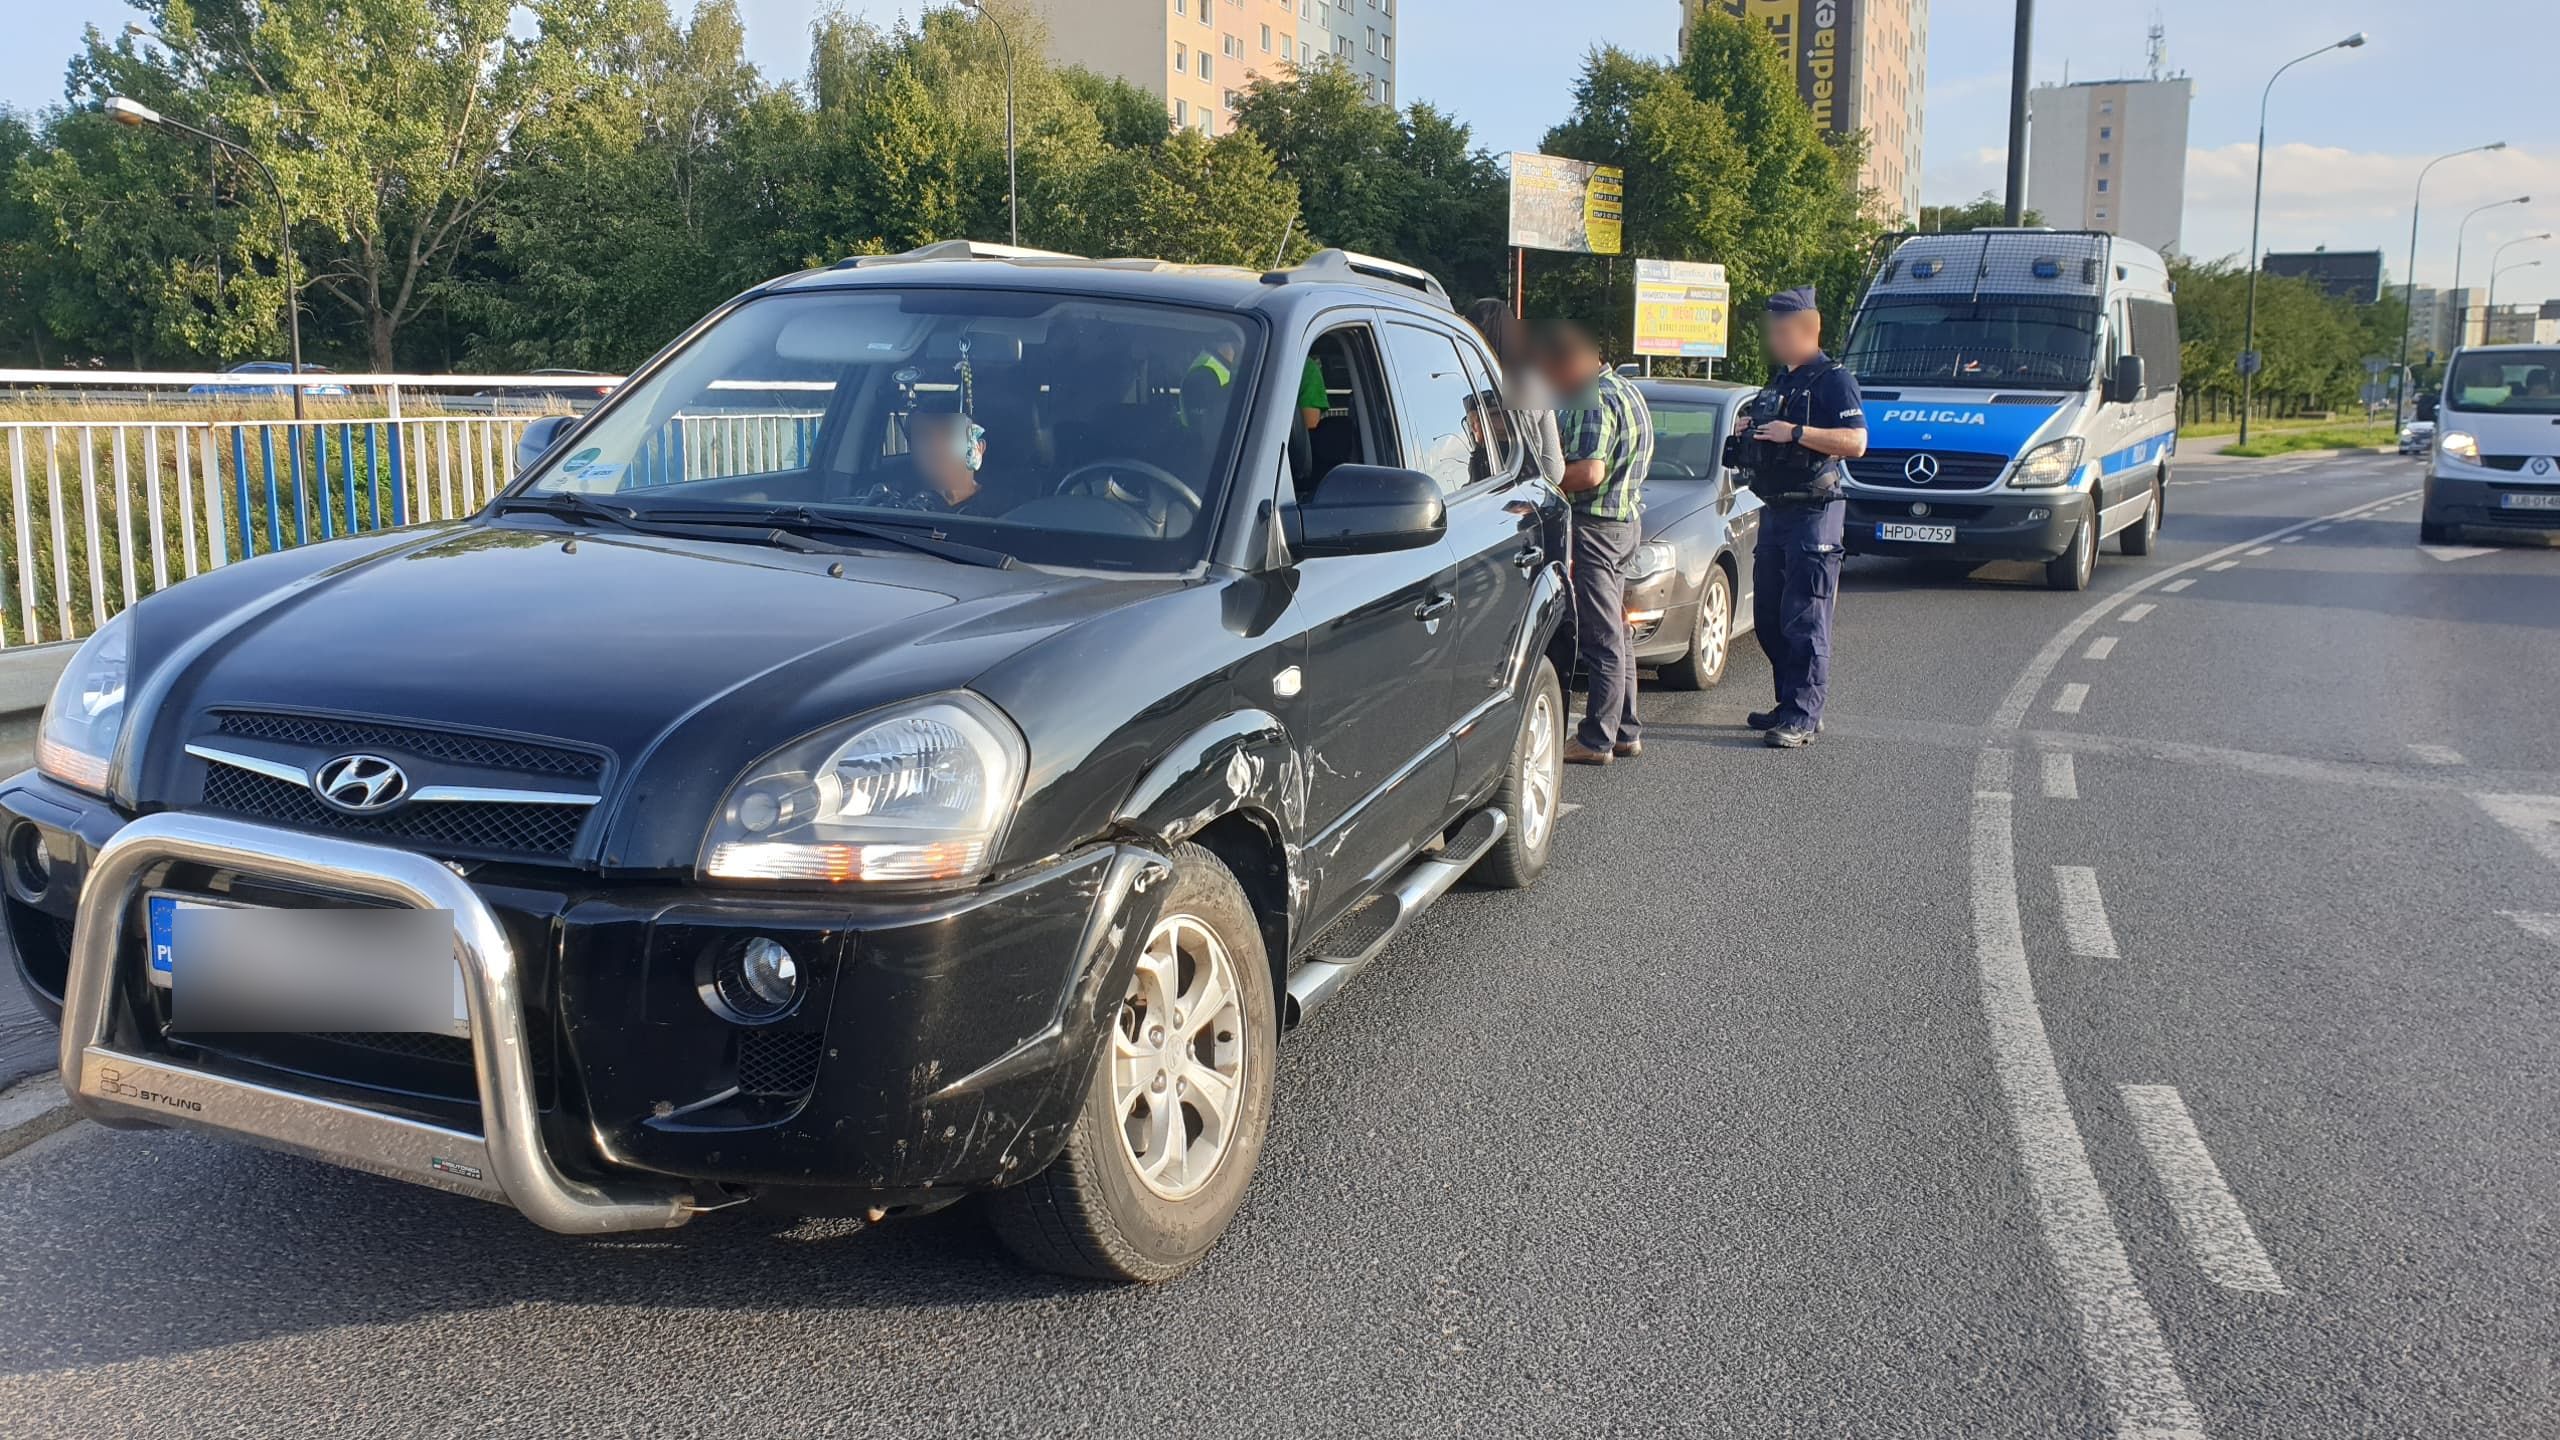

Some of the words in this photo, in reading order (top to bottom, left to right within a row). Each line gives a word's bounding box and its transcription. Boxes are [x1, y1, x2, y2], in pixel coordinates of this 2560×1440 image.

[1883, 409, 1985, 425] POLICJA
[1884, 525, 1914, 539] HPD
[1918, 527, 1952, 541] C759
[140, 1090, 202, 1112] STYLING
